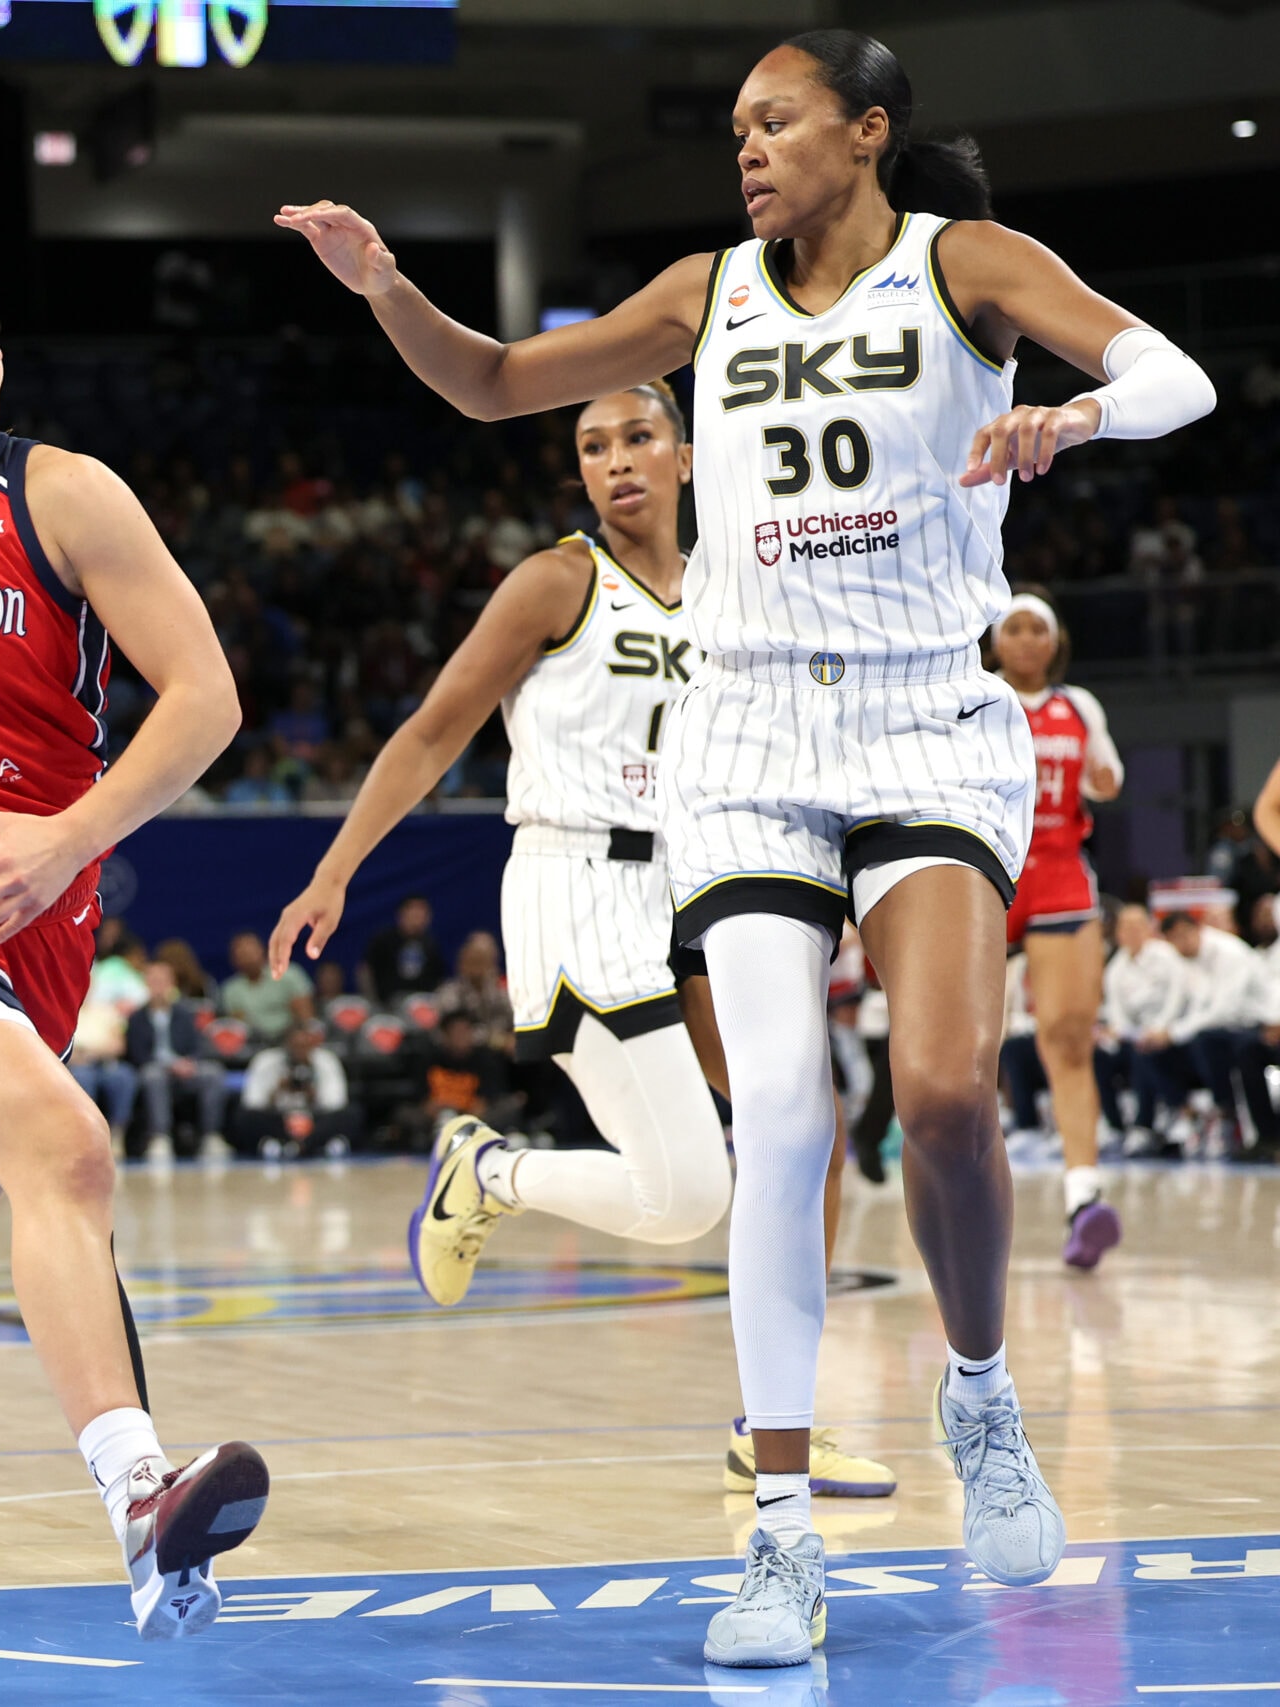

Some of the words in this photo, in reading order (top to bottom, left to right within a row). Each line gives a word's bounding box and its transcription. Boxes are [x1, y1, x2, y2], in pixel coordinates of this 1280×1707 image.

[719, 326, 922, 413] SKY
[761, 416, 874, 498] 30
[786, 509, 898, 538] UChicago
[789, 531, 900, 562] Medicine
[607, 630, 707, 686] SK
[1035, 765, 1065, 807] 4
